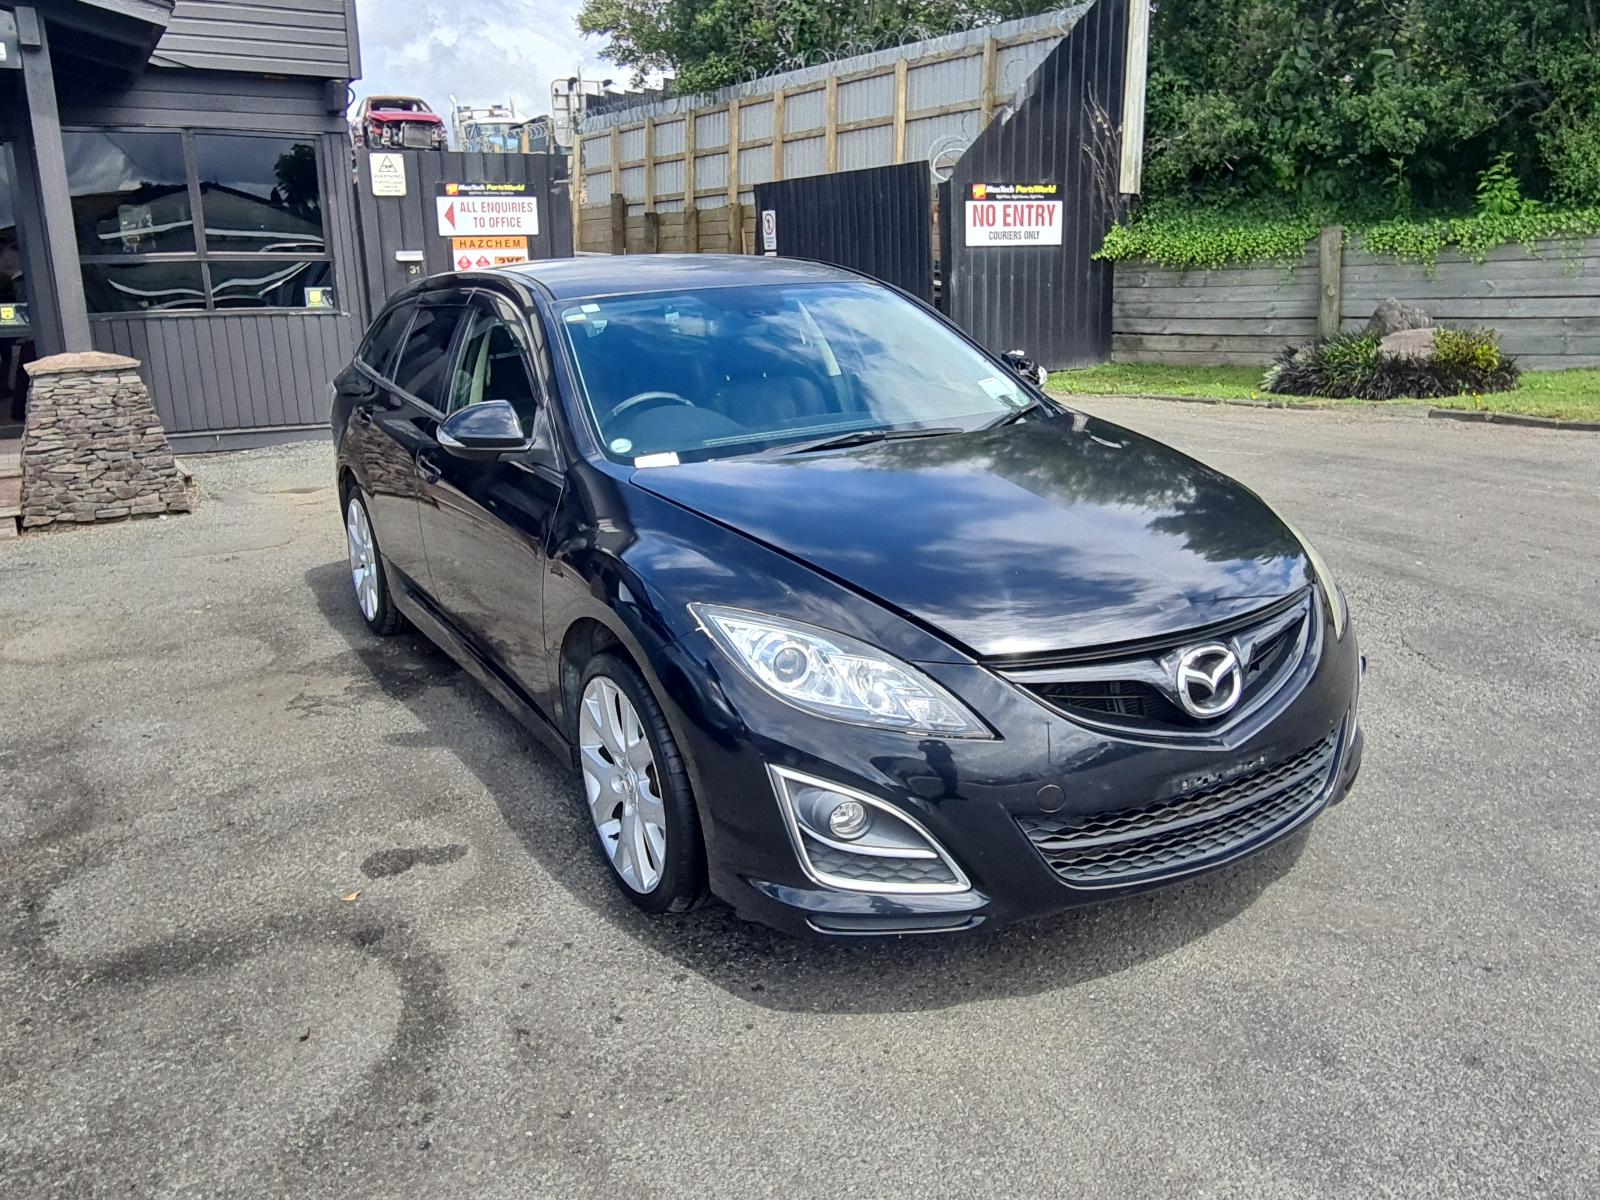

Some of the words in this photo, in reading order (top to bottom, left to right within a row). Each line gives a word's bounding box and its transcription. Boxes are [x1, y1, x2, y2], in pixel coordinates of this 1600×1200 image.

[1015, 184, 1057, 193] PartsWorld
[460, 202, 478, 213] ALL
[481, 202, 533, 213] ENQUIRIES
[972, 204, 997, 227] NO
[1002, 204, 1056, 227] ENTRY
[473, 217, 486, 228] TO
[489, 217, 522, 228] OFFICE
[988, 230, 1022, 240] COURIERS
[1023, 230, 1040, 240] ONLY
[459, 239, 521, 248] HAZCHEM
[409, 265, 421, 274] 31
